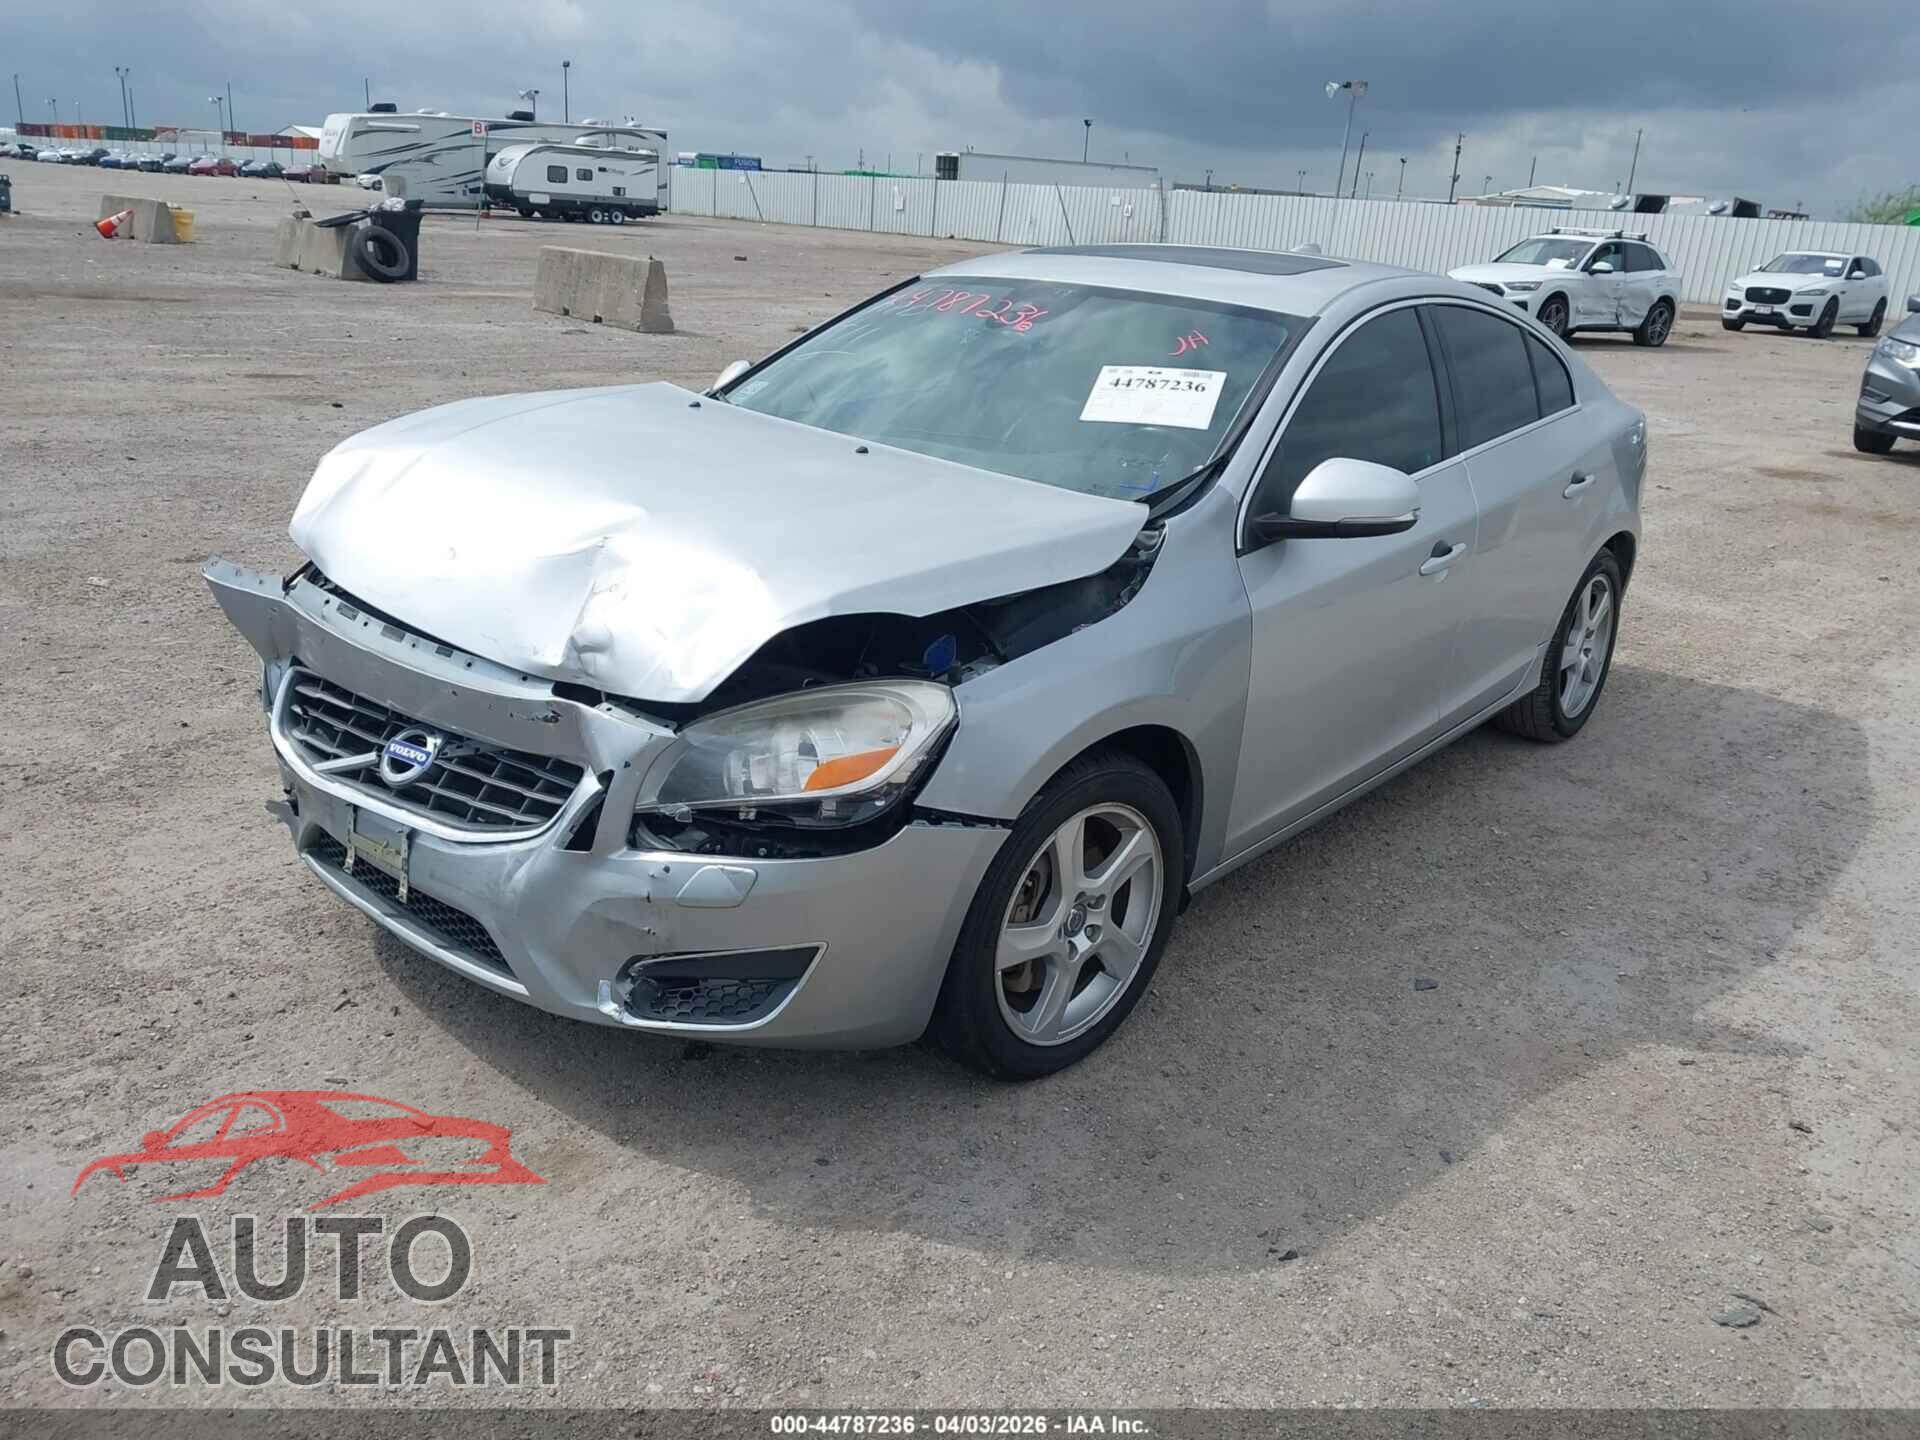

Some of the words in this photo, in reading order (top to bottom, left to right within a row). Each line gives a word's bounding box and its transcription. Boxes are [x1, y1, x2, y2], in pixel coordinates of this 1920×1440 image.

[474, 122, 482, 134] B
[1109, 376, 1207, 393] 44787236
[389, 743, 427, 762] VOLVO
